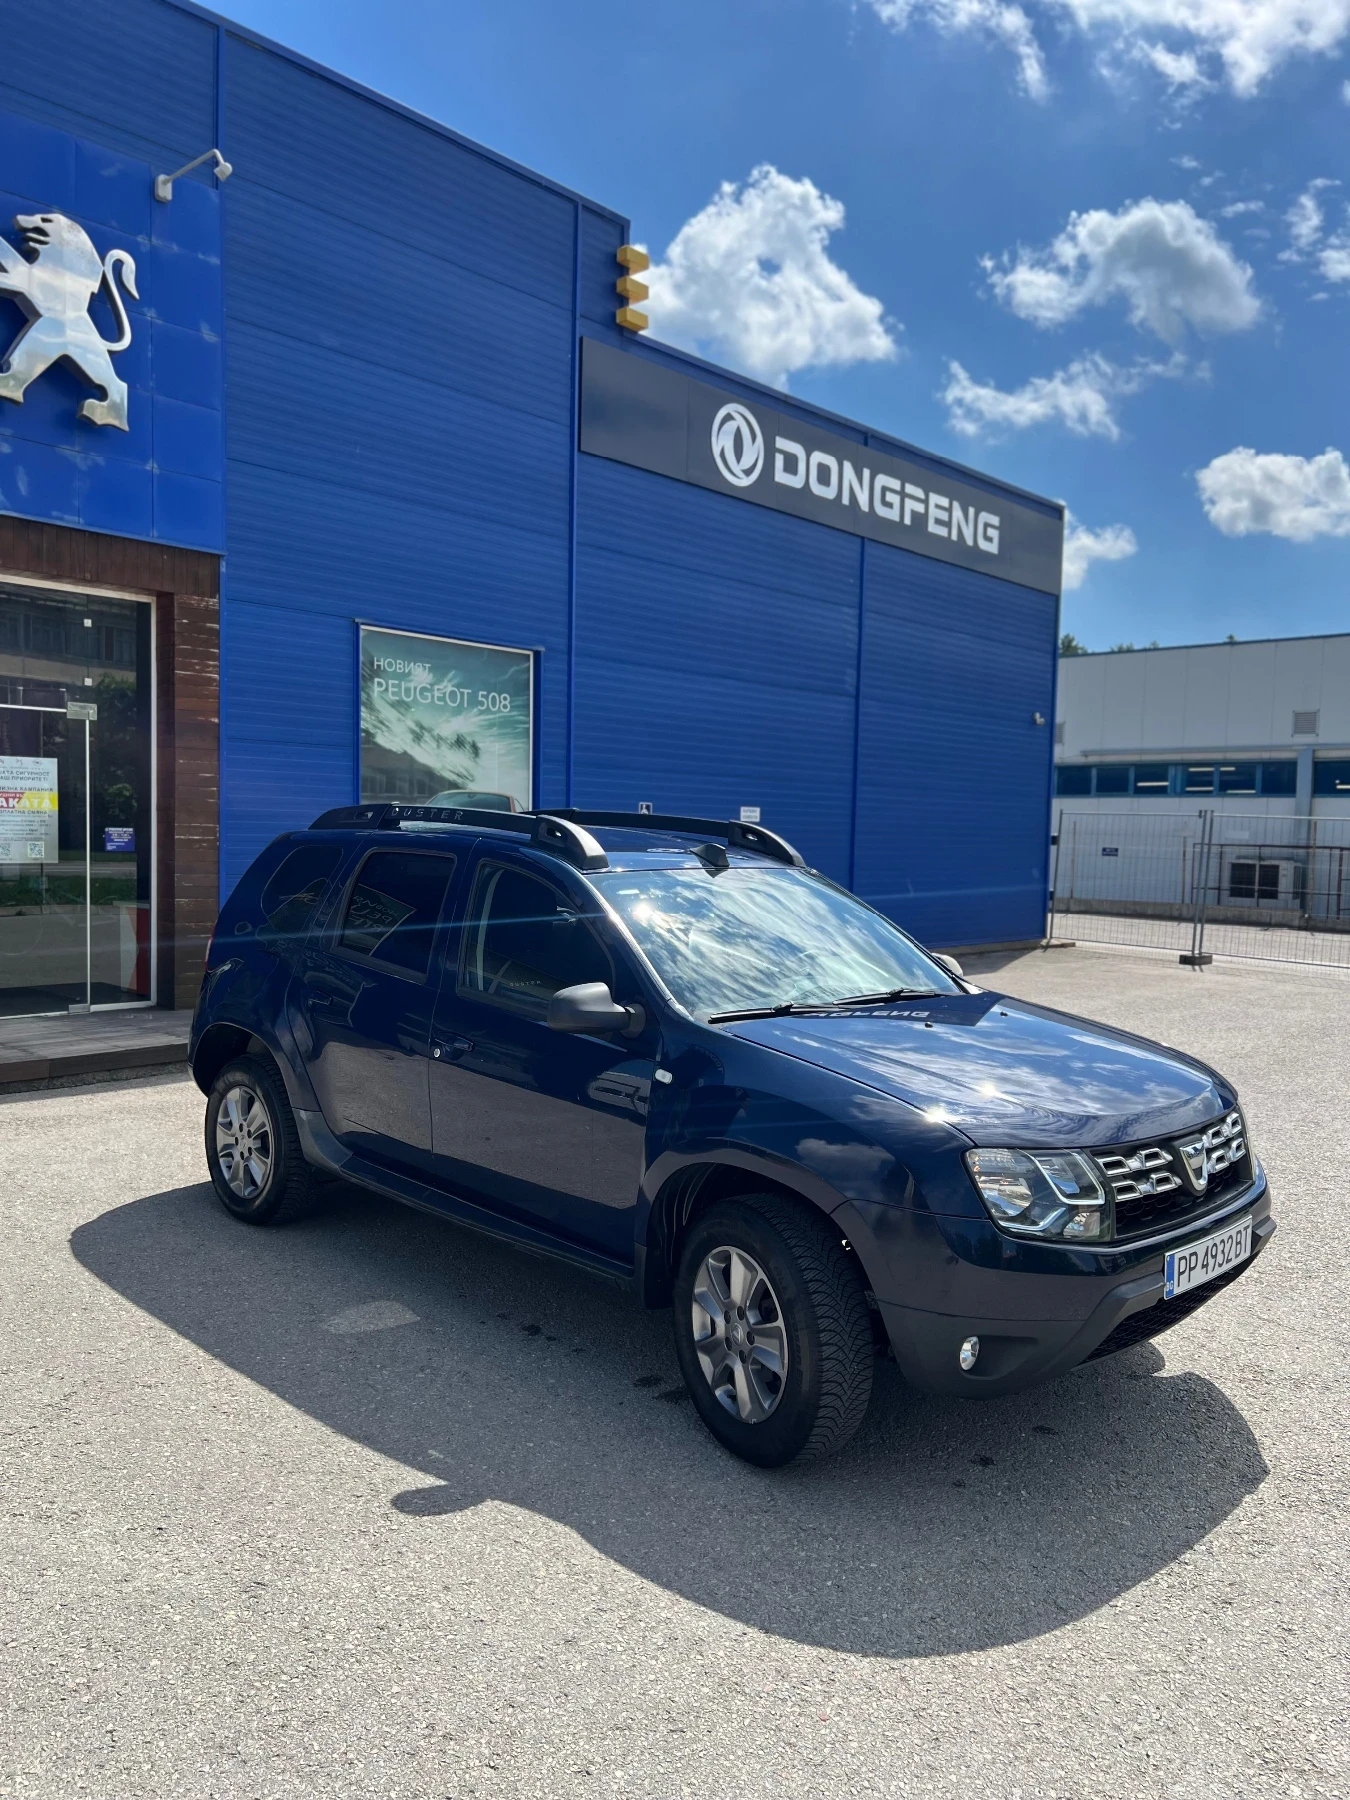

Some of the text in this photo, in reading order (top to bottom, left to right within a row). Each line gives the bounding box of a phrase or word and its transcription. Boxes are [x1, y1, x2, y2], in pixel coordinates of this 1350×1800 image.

[774, 436, 1000, 555] DONGFENG
[373, 656, 432, 674] НОВИЯТ
[373, 677, 511, 713] PEUGEOT 508
[391, 807, 464, 821] DUSTER
